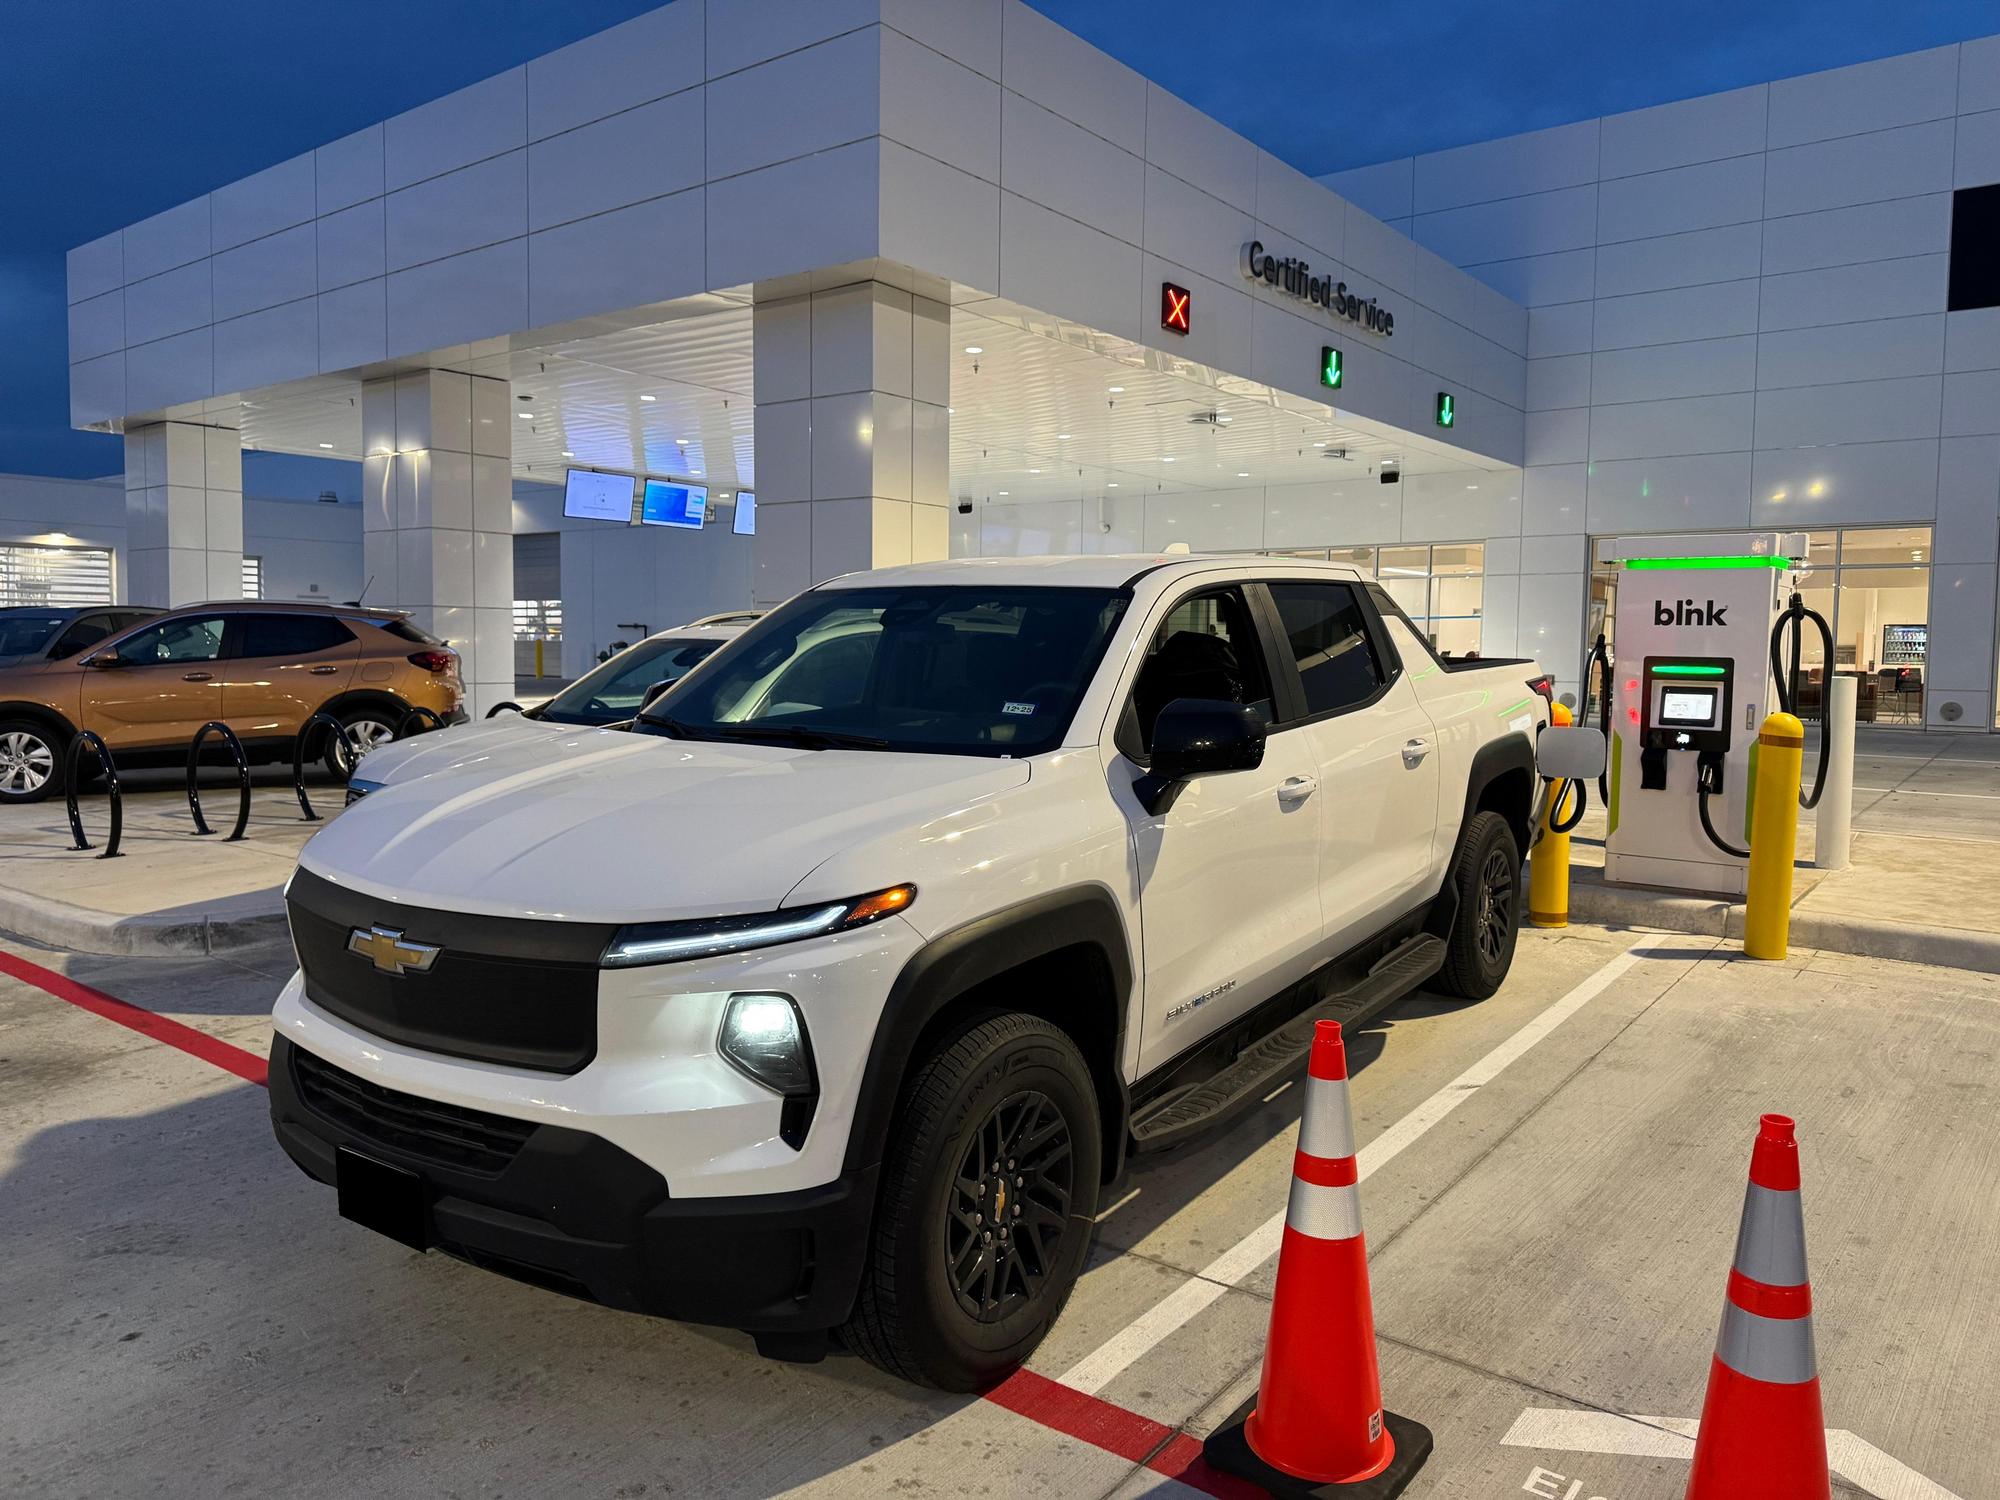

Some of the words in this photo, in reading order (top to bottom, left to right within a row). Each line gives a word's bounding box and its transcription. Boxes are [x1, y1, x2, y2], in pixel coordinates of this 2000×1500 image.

[1247, 240, 1332, 308] Certified
[1336, 281, 1394, 337] Service
[1654, 599, 1728, 626] blink
[1522, 1465, 1607, 1500] El
